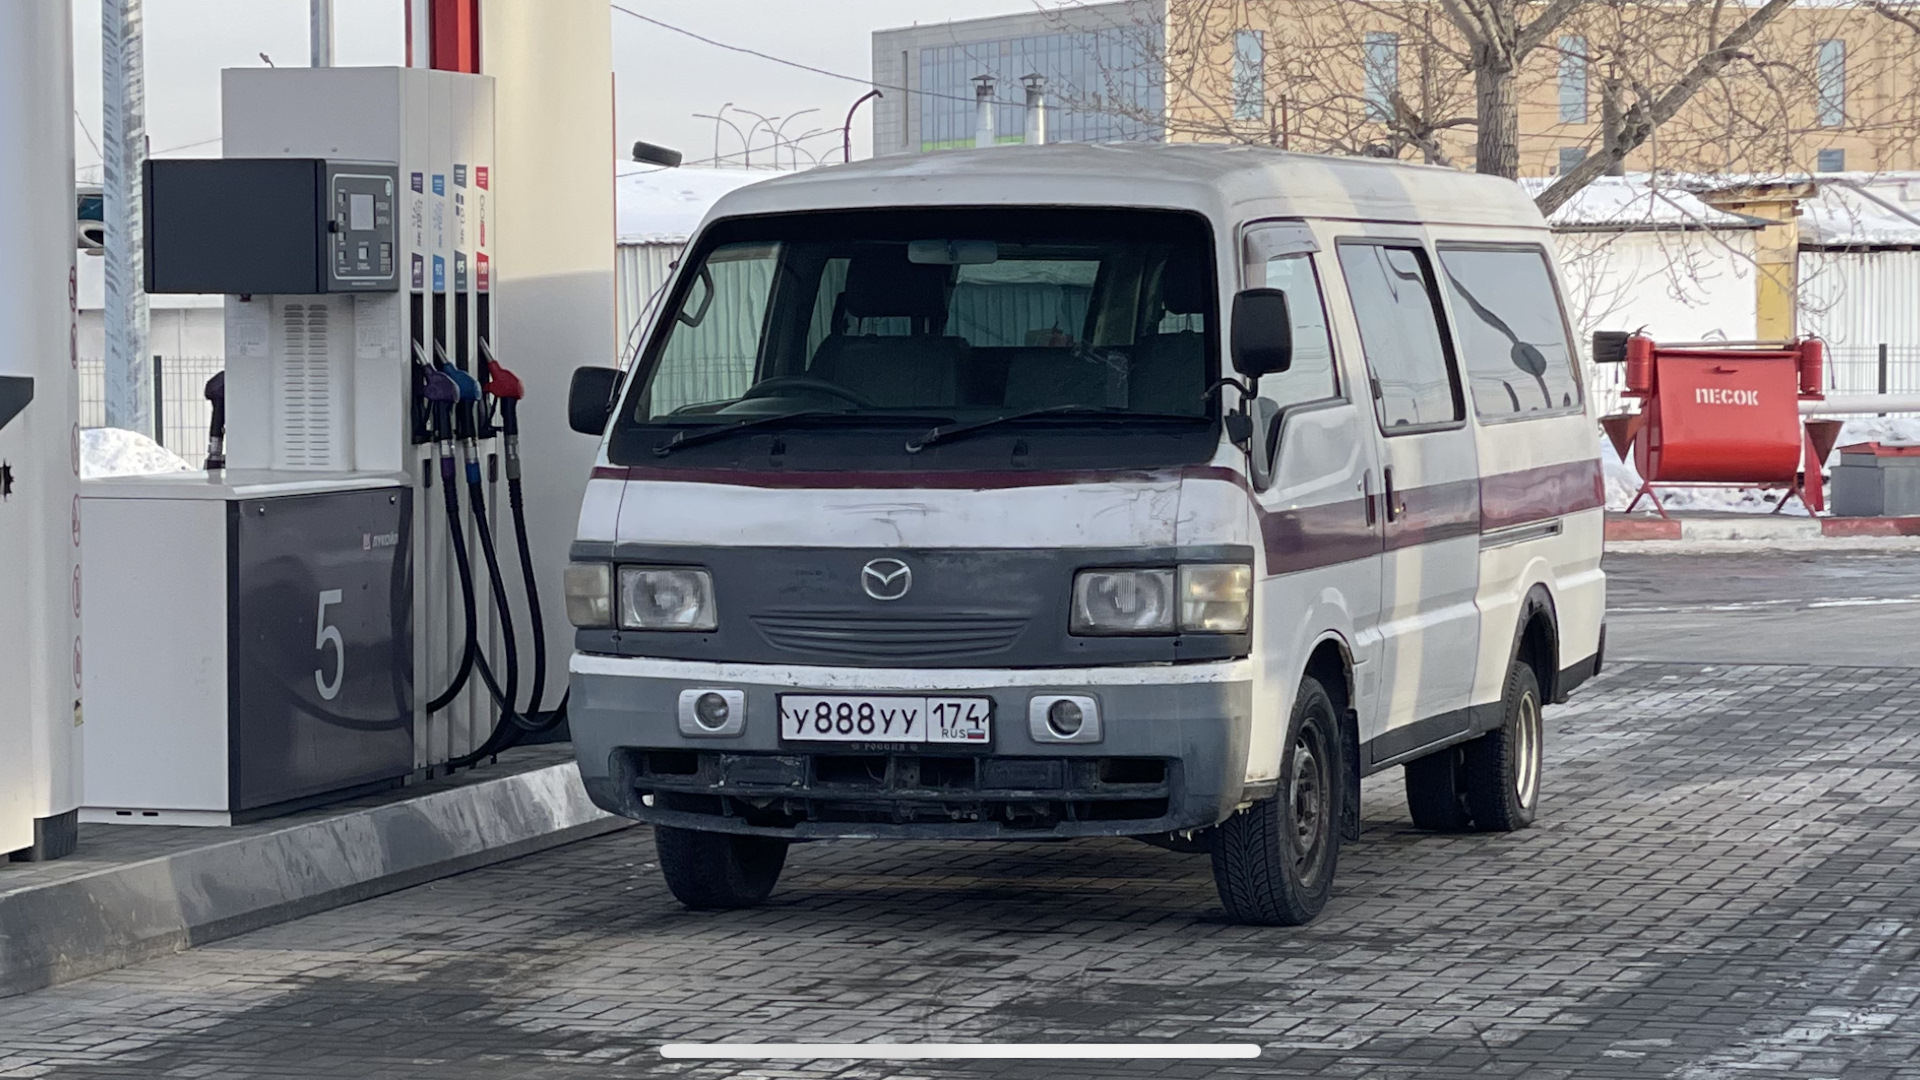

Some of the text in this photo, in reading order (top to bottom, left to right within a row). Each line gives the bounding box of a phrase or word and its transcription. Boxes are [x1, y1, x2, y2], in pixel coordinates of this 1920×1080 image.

[456, 260, 465, 274] 95
[1695, 388, 1759, 406] ПЕСОК
[315, 589, 345, 700] 5
[932, 703, 980, 729] 174
[941, 728, 966, 739] RUS
